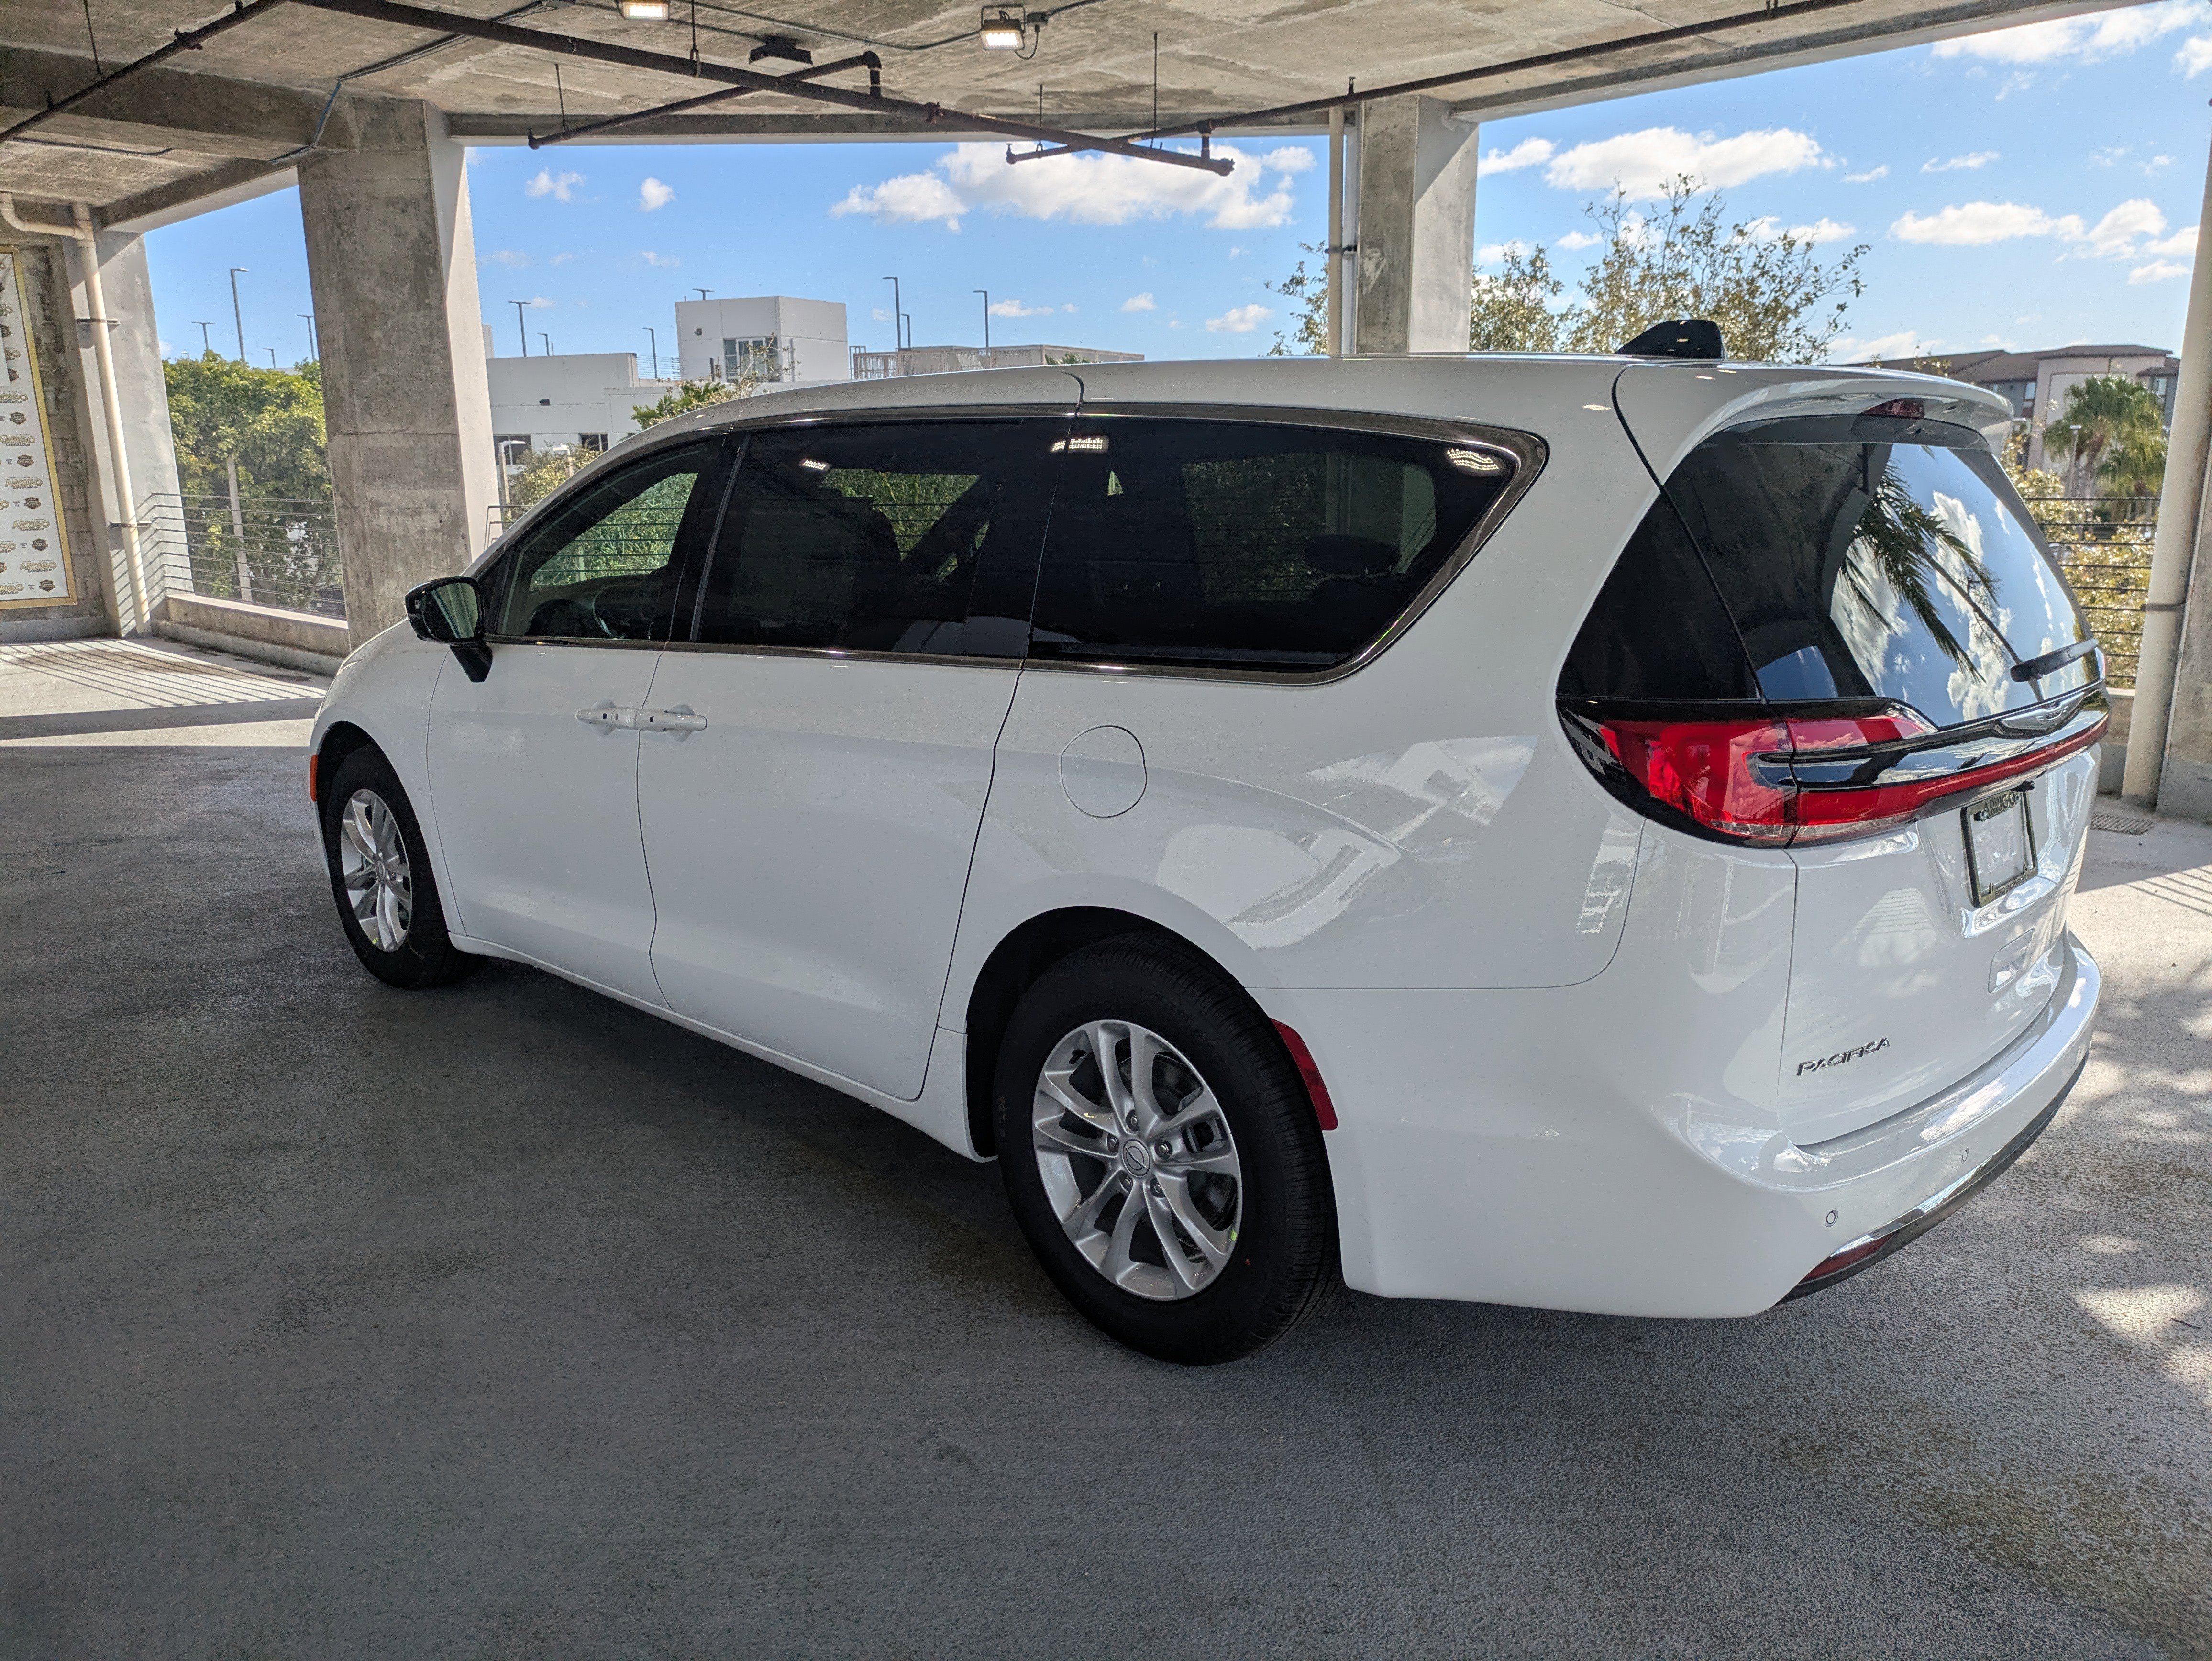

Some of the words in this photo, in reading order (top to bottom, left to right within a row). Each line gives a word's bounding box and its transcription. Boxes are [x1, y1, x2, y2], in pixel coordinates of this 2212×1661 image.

[5, 478, 43, 487] ARRIGO
[12, 520, 50, 529] ARRIGO
[20, 561, 57, 570] ARRIGO
[1981, 790, 2016, 819] ARRIGO
[1797, 1038, 1890, 1076] PACIFICA
